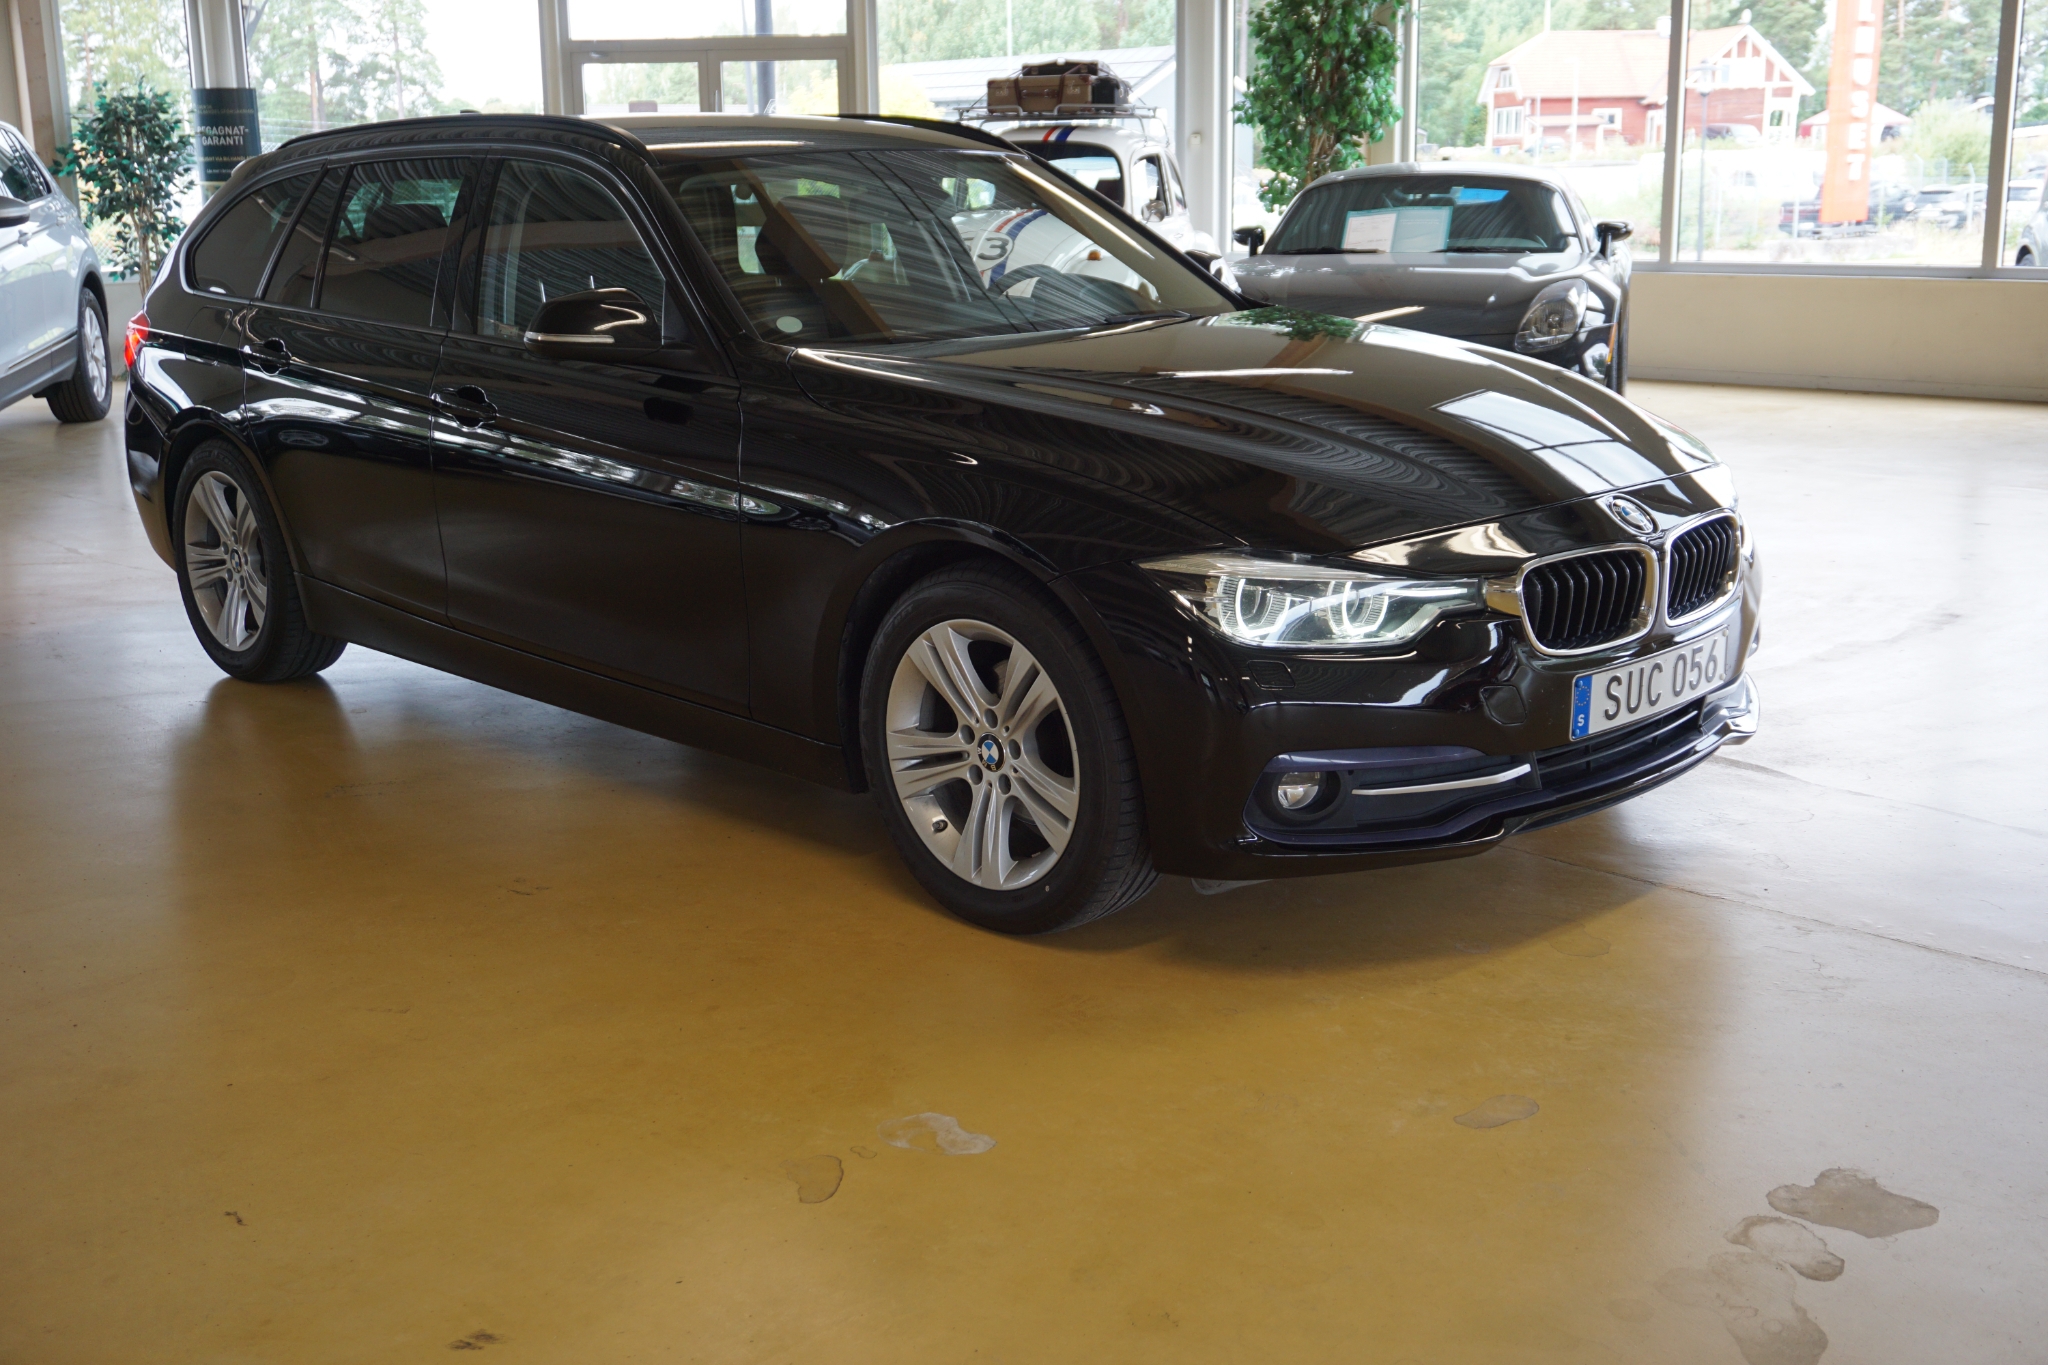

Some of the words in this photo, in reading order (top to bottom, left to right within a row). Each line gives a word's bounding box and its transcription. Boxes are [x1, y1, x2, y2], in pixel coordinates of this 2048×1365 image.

[201, 135, 244, 146] GARANTI
[1604, 661, 1664, 721] SUC
[1672, 637, 1718, 698] 056
[1576, 713, 1585, 728] S
